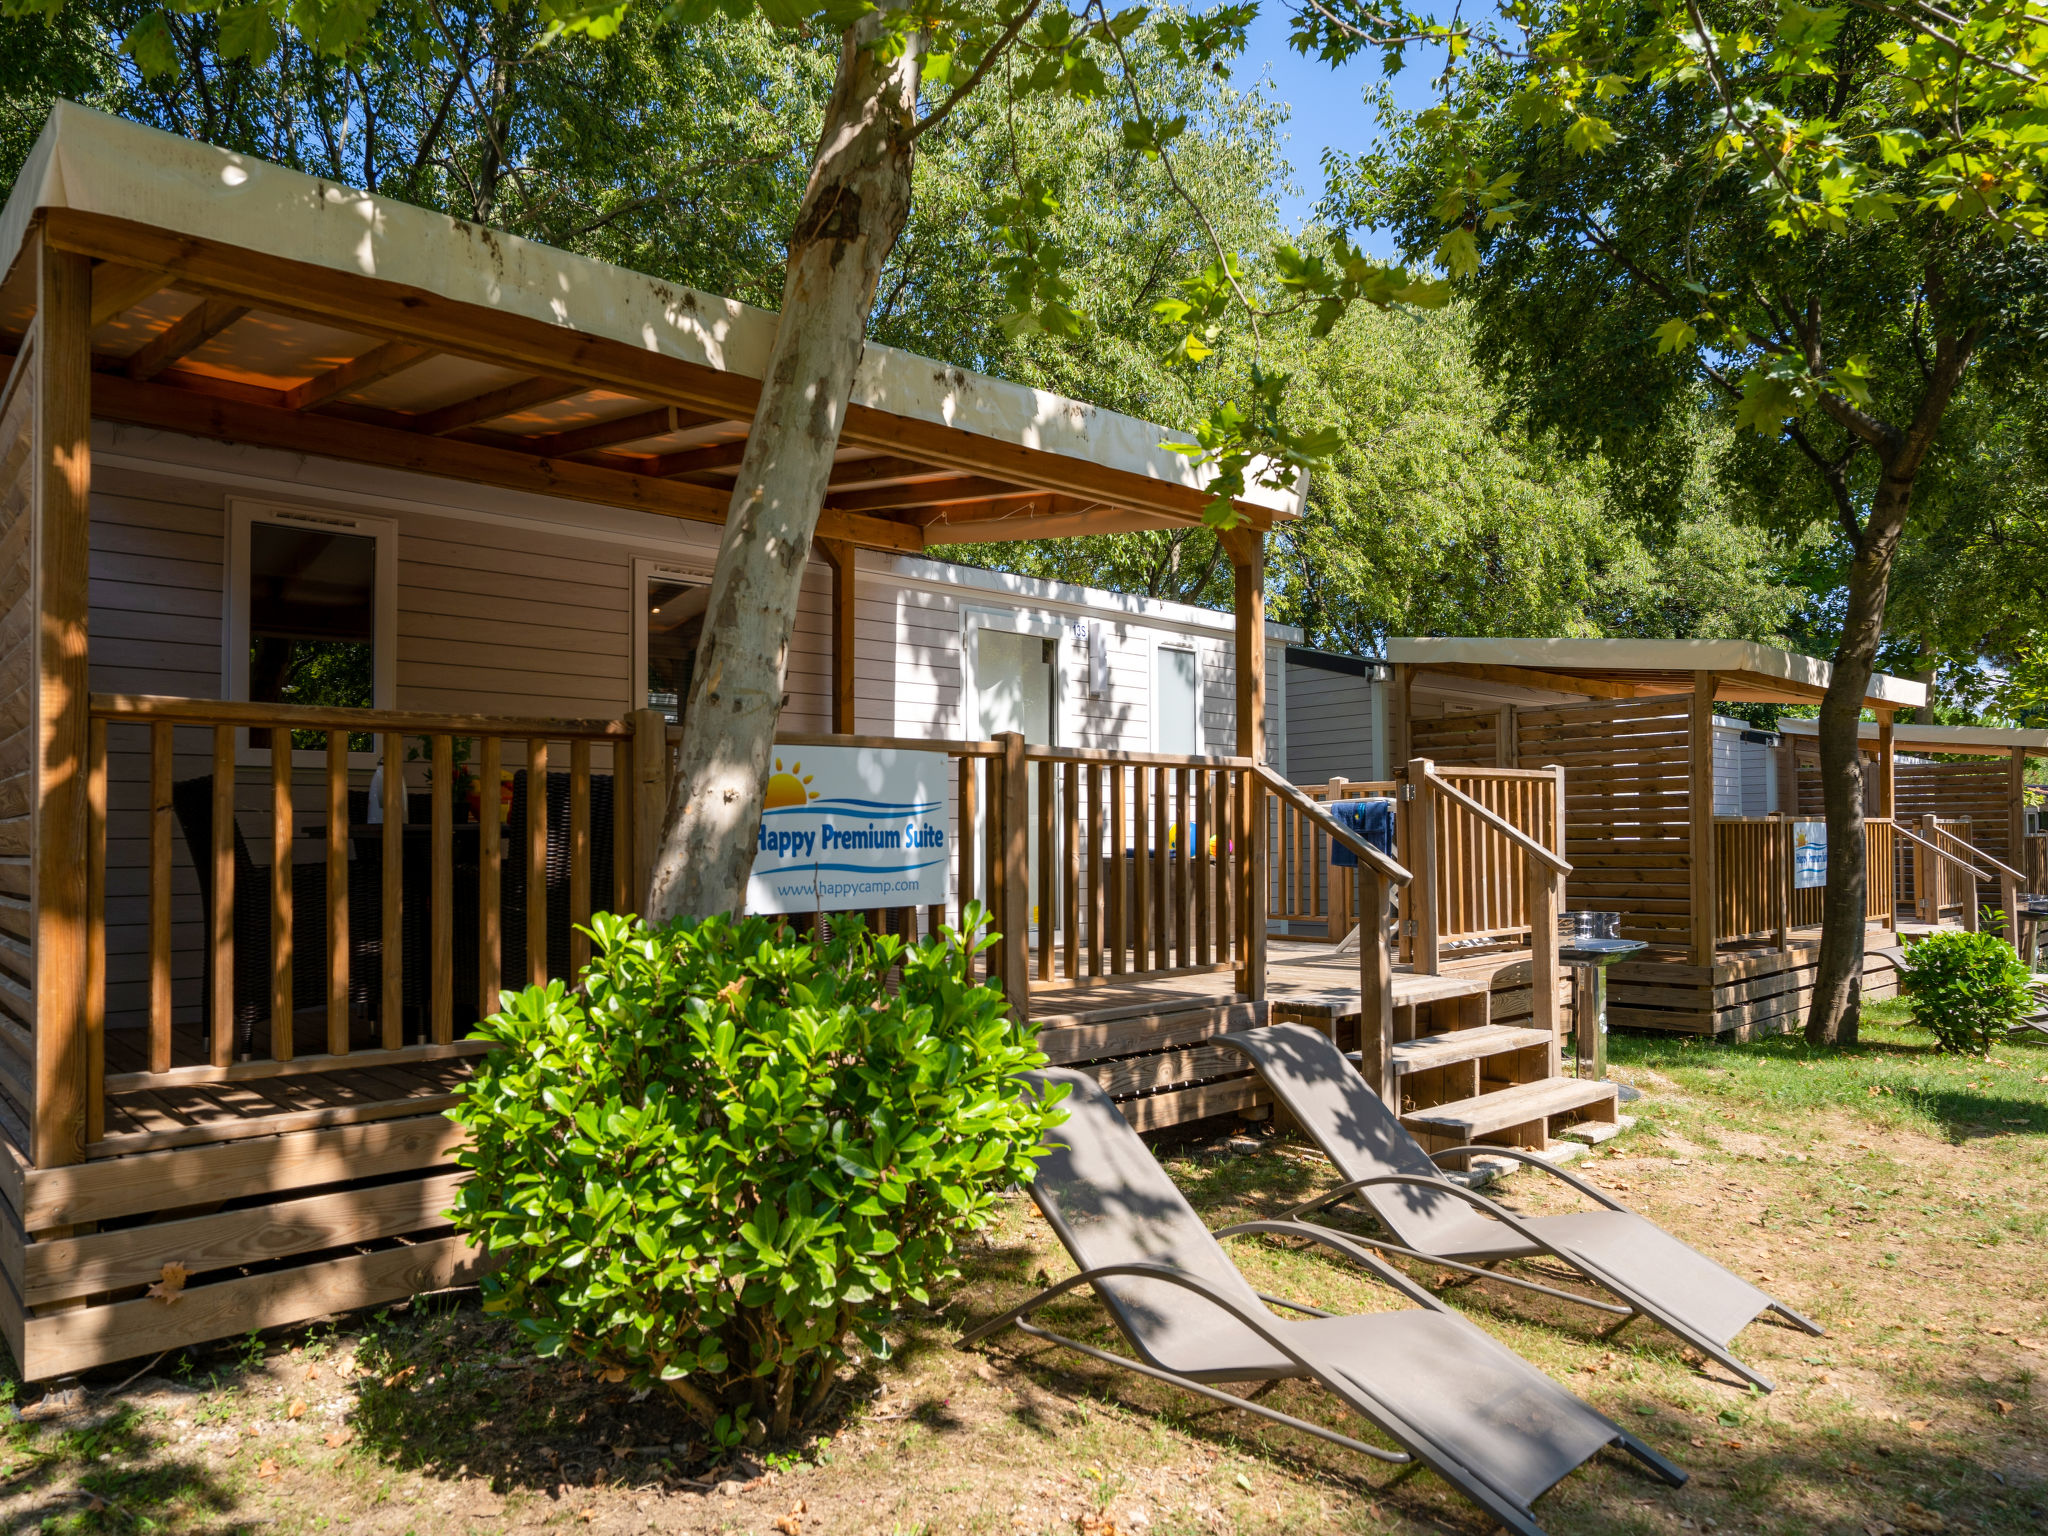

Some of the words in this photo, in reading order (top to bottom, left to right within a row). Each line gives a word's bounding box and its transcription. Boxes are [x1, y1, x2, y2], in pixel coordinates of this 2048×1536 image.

[821, 823, 900, 850] Premium
[905, 823, 944, 849] Suite
[777, 880, 919, 897] wwwhappycamp.com
